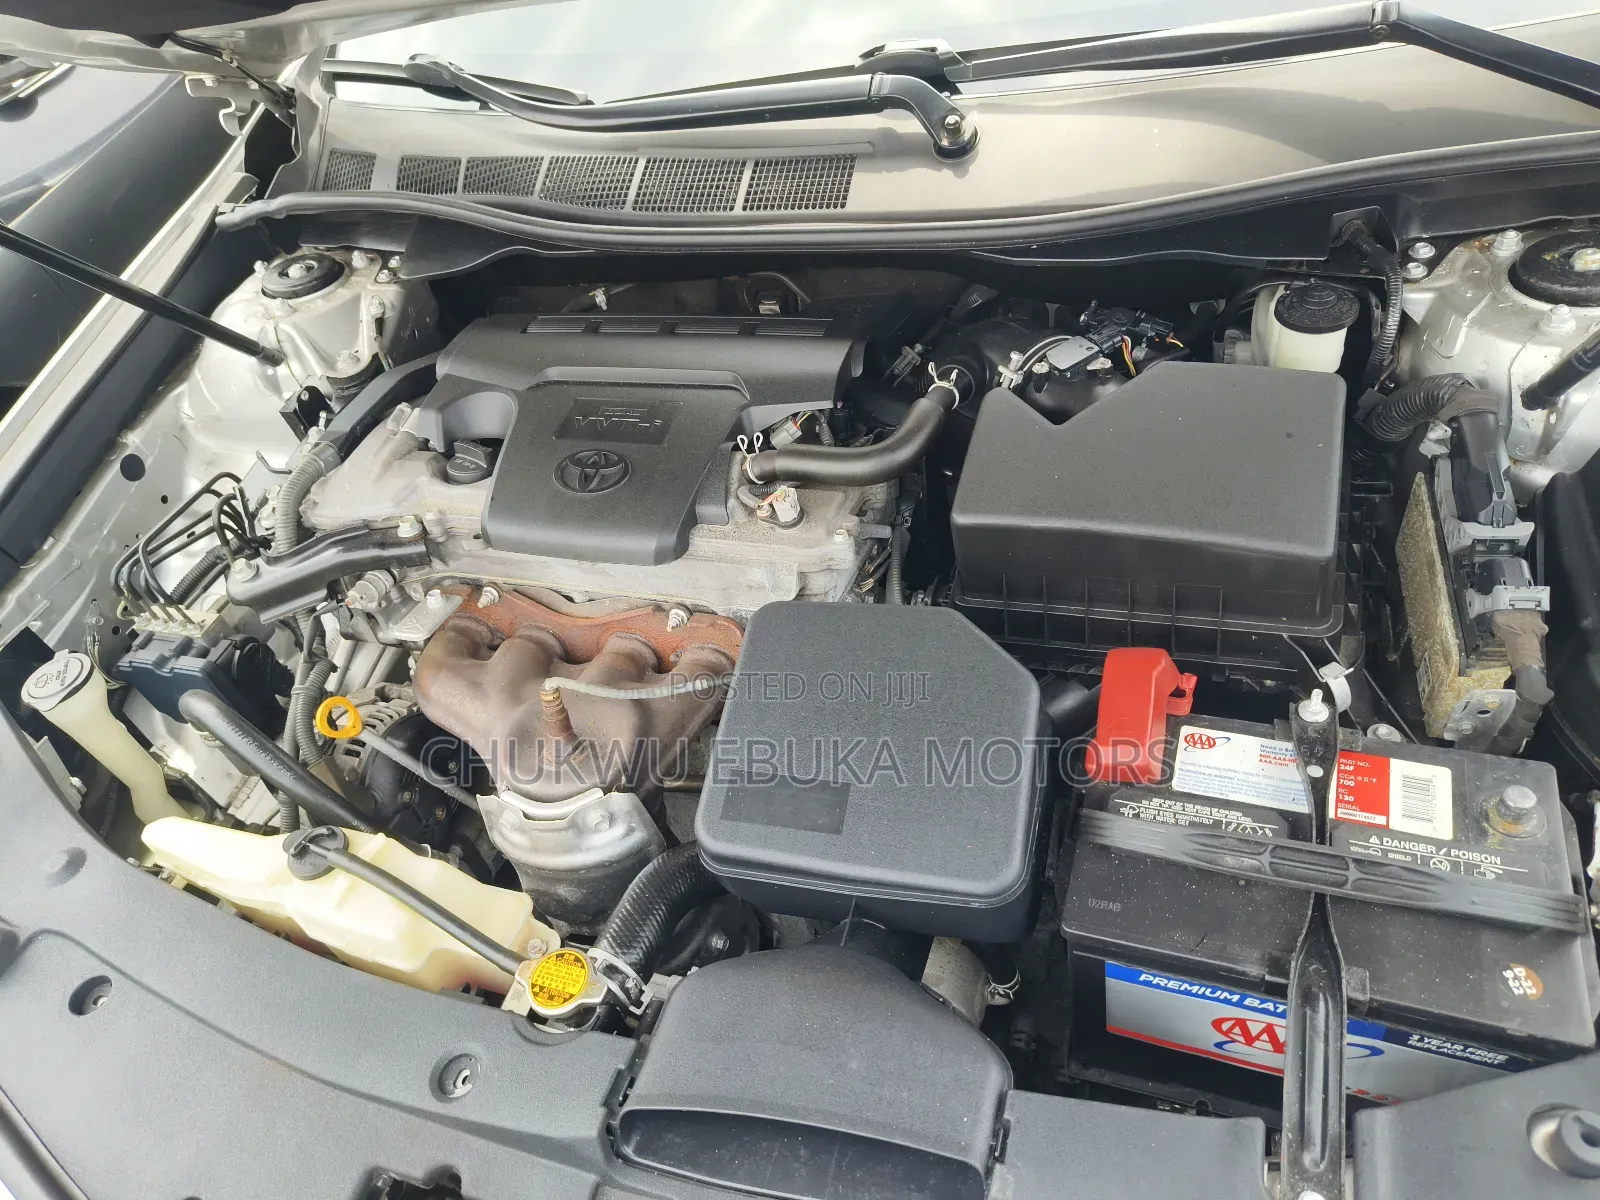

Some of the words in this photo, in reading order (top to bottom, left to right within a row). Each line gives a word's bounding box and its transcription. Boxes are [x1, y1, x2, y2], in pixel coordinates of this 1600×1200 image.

[1184, 733, 1216, 750] AAA
[1258, 759, 1289, 767] AAA.com
[1339, 773, 1355, 781] CCA
[1339, 779, 1355, 787] 700
[1338, 794, 1354, 802] 130
[1337, 802, 1361, 811] SERIAL
[1139, 808, 1158, 816] FLUSH
[1159, 810, 1174, 818] EYES
[1382, 837, 1437, 855] DANGER
[1450, 850, 1501, 865] POISON
[557, 957, 583, 968] CAUTION
[542, 986, 571, 999] ATTENTION
[1139, 973, 1242, 1003] PREMIUM
[1243, 997, 1287, 1014] BAT
[1406, 1040, 1506, 1065] REPLACEMENT
[1423, 1036, 1465, 1051] YEAR
[1466, 1047, 1510, 1062] FREE
